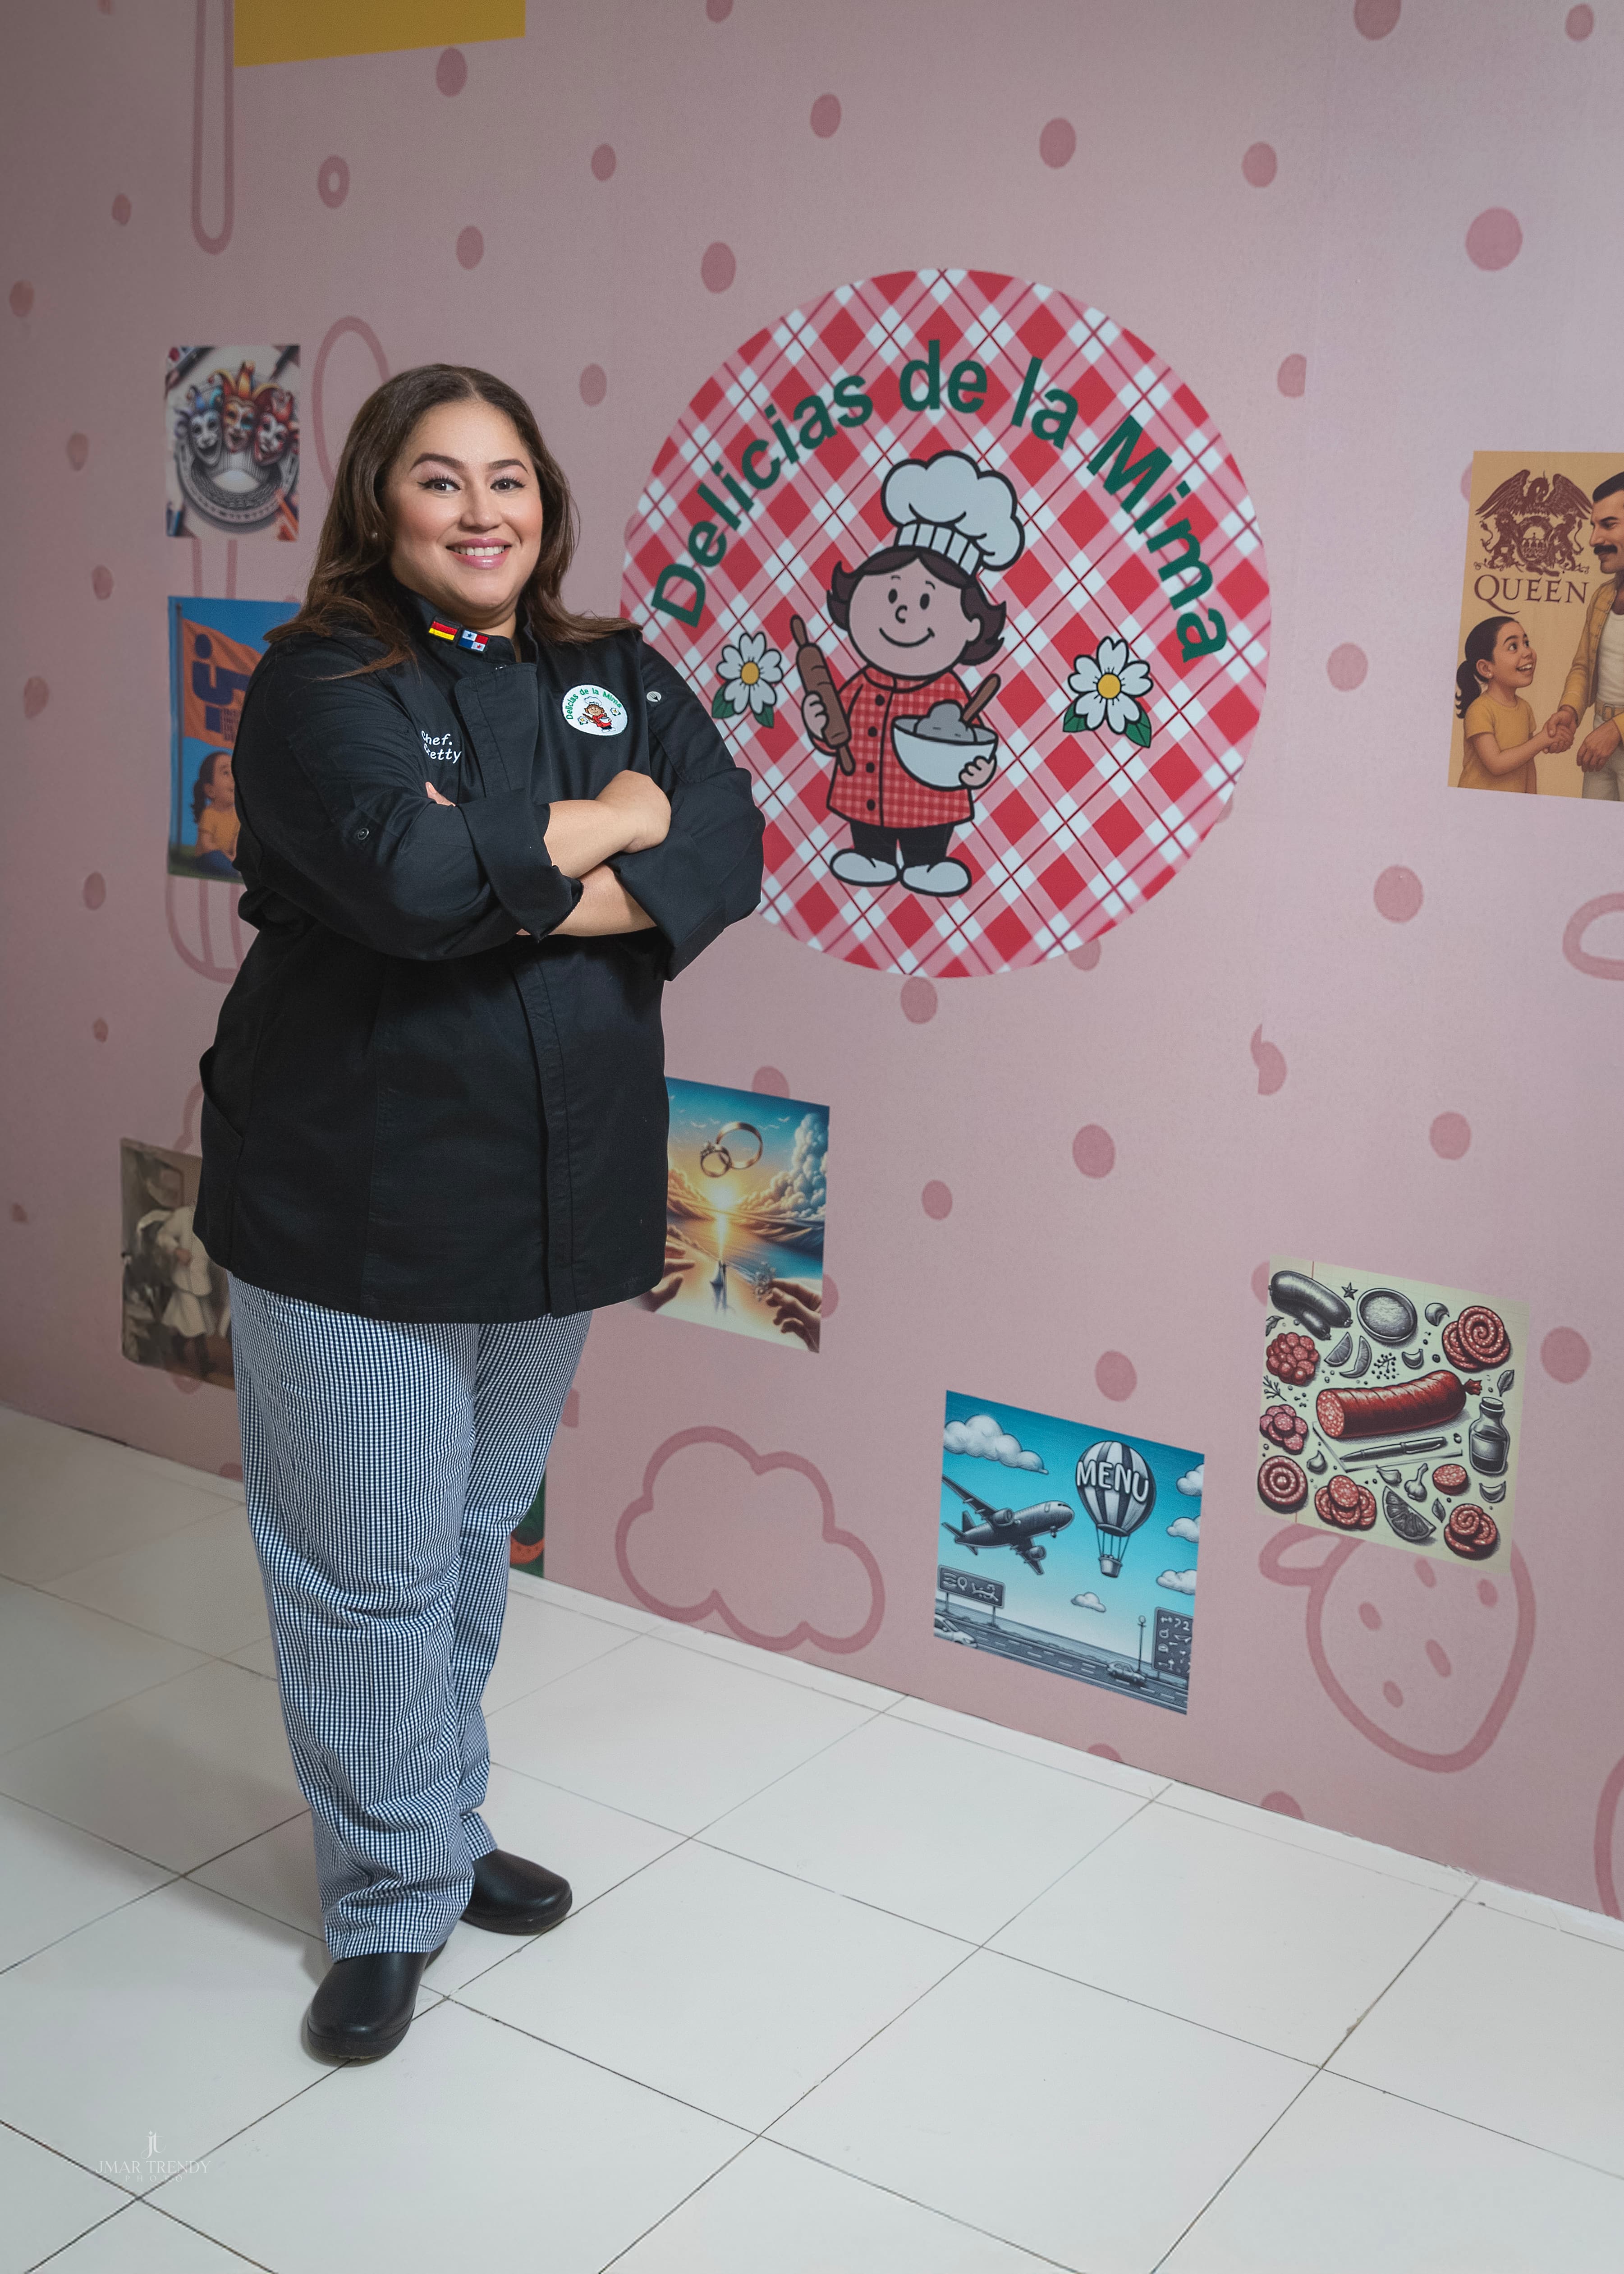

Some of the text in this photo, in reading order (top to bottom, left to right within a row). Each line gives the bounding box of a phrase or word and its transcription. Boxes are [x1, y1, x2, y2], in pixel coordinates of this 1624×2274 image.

[651, 340, 1227, 662] Delicias de la Mima
[1474, 574, 1588, 615] QUEEN
[564, 694, 578, 720] Delicias
[603, 691, 622, 708] Mima
[421, 730, 453, 746] Chef.
[1075, 1459, 1149, 1503] MENU
